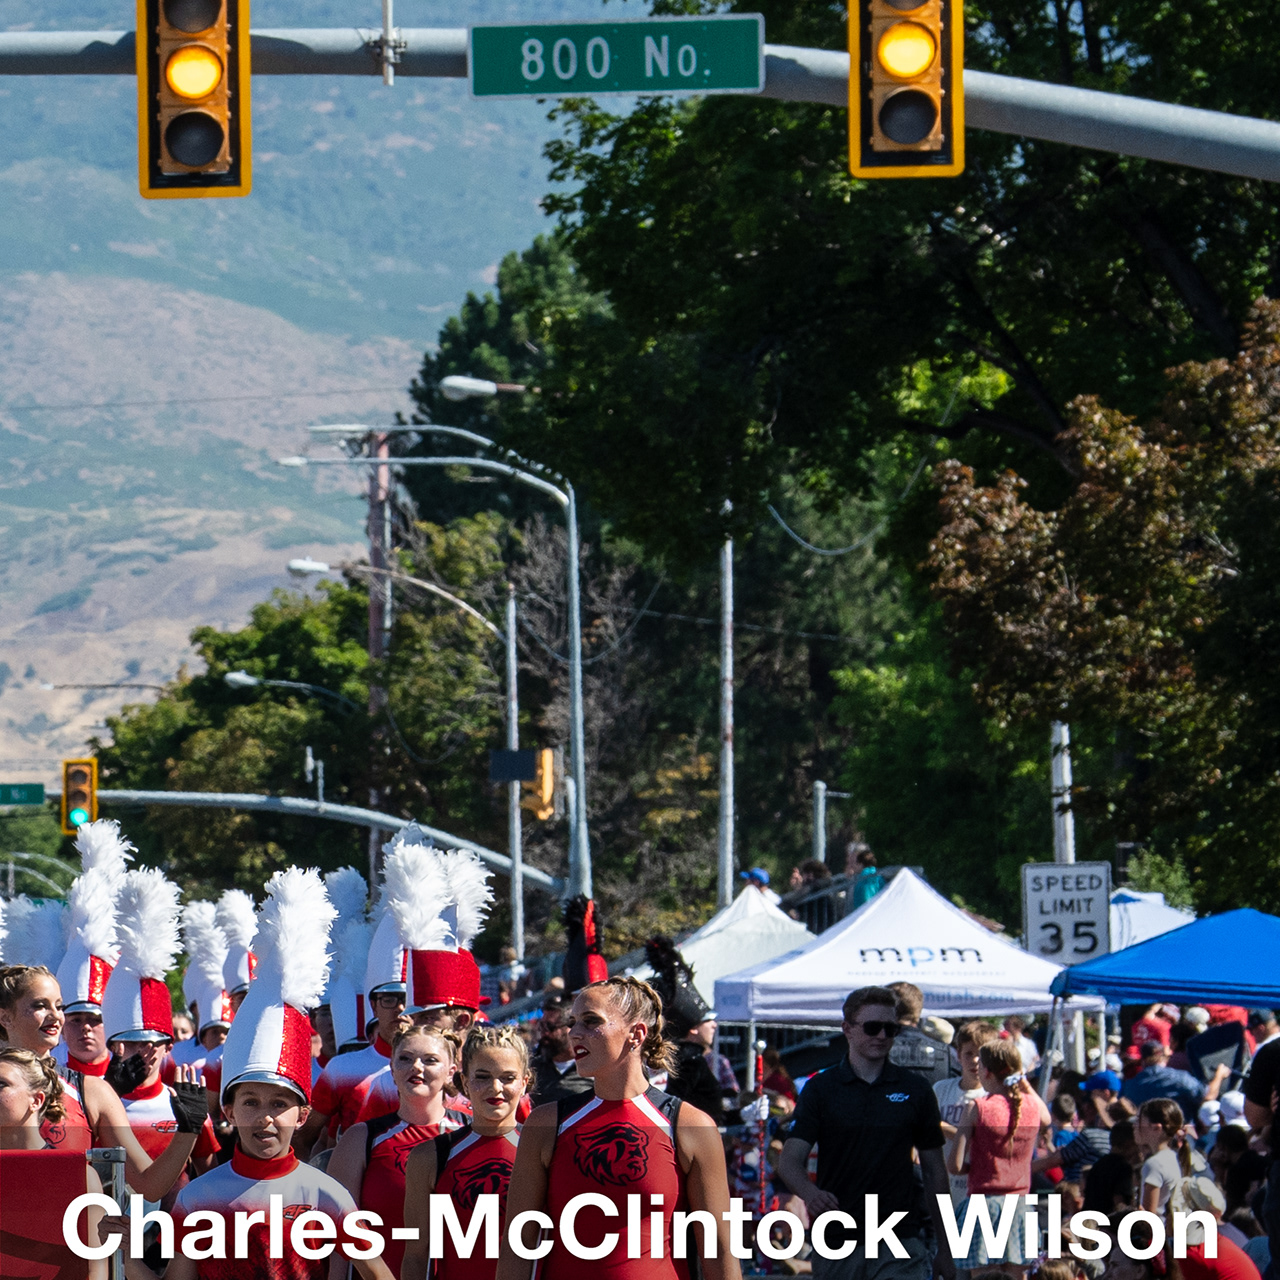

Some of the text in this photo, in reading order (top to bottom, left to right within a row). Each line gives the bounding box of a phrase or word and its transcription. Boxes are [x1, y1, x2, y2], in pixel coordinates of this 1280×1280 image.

[520, 35, 711, 81] 800 No.
[1031, 874, 1103, 892] SPEED
[1040, 897, 1094, 915] LIMIT
[1040, 921, 1099, 955] 35
[859, 946, 983, 968] mpm
